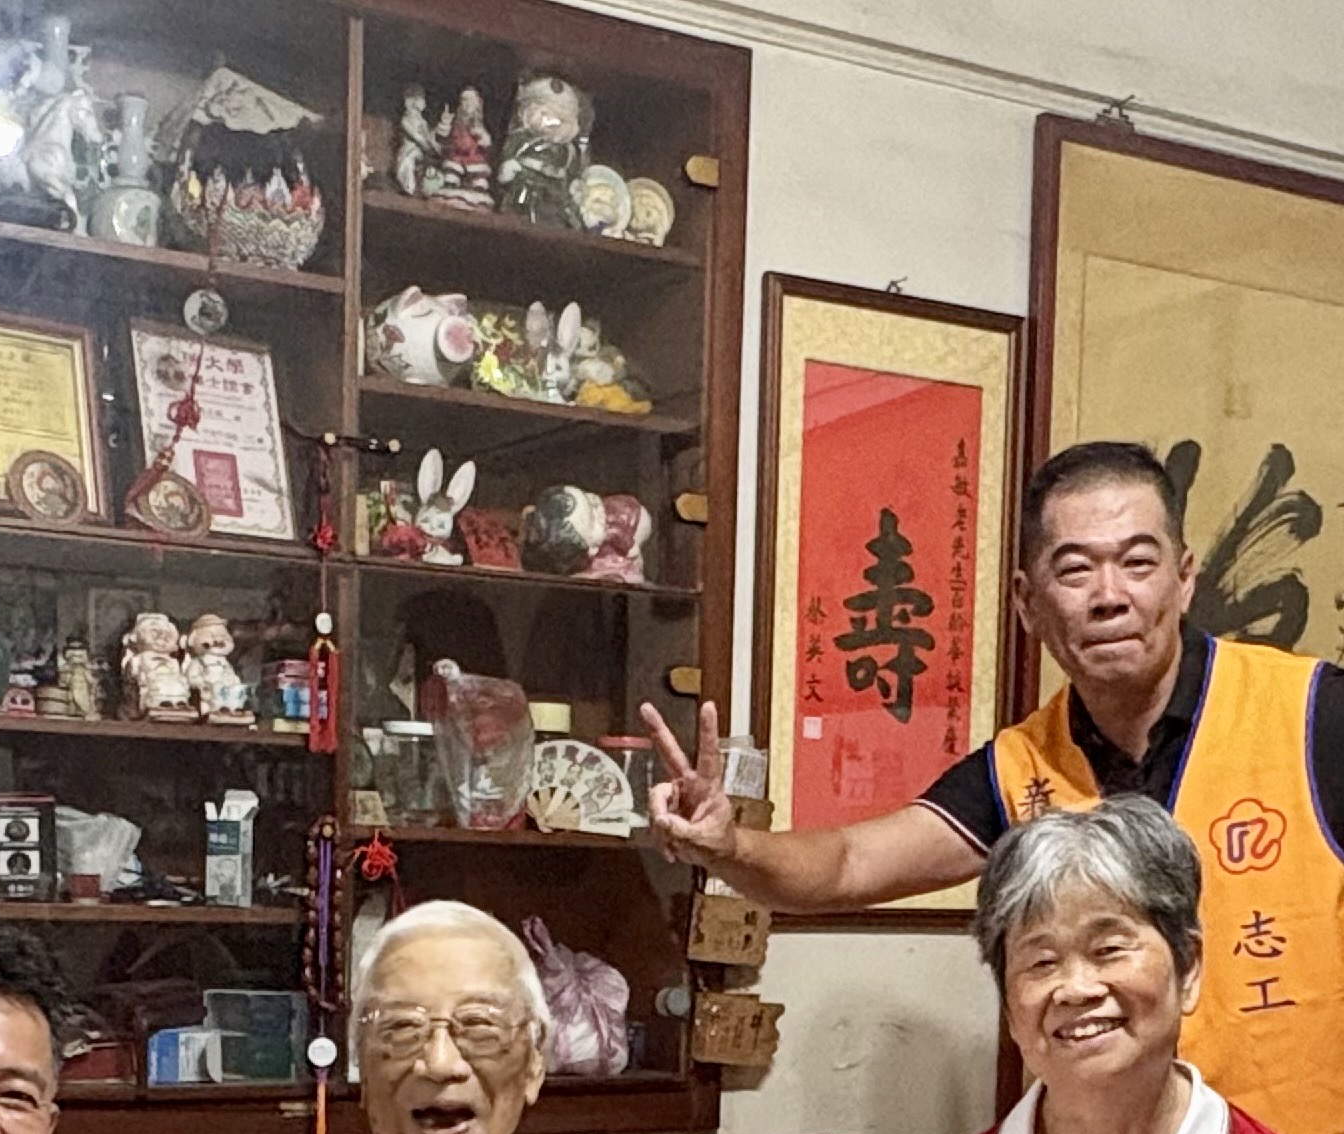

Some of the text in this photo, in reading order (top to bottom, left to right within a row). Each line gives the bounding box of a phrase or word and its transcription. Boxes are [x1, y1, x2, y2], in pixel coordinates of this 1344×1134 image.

[804, 596, 827, 702] 蔡英文
[834, 507, 936, 724] 壽
[1232, 910, 1297, 1013] 志工
